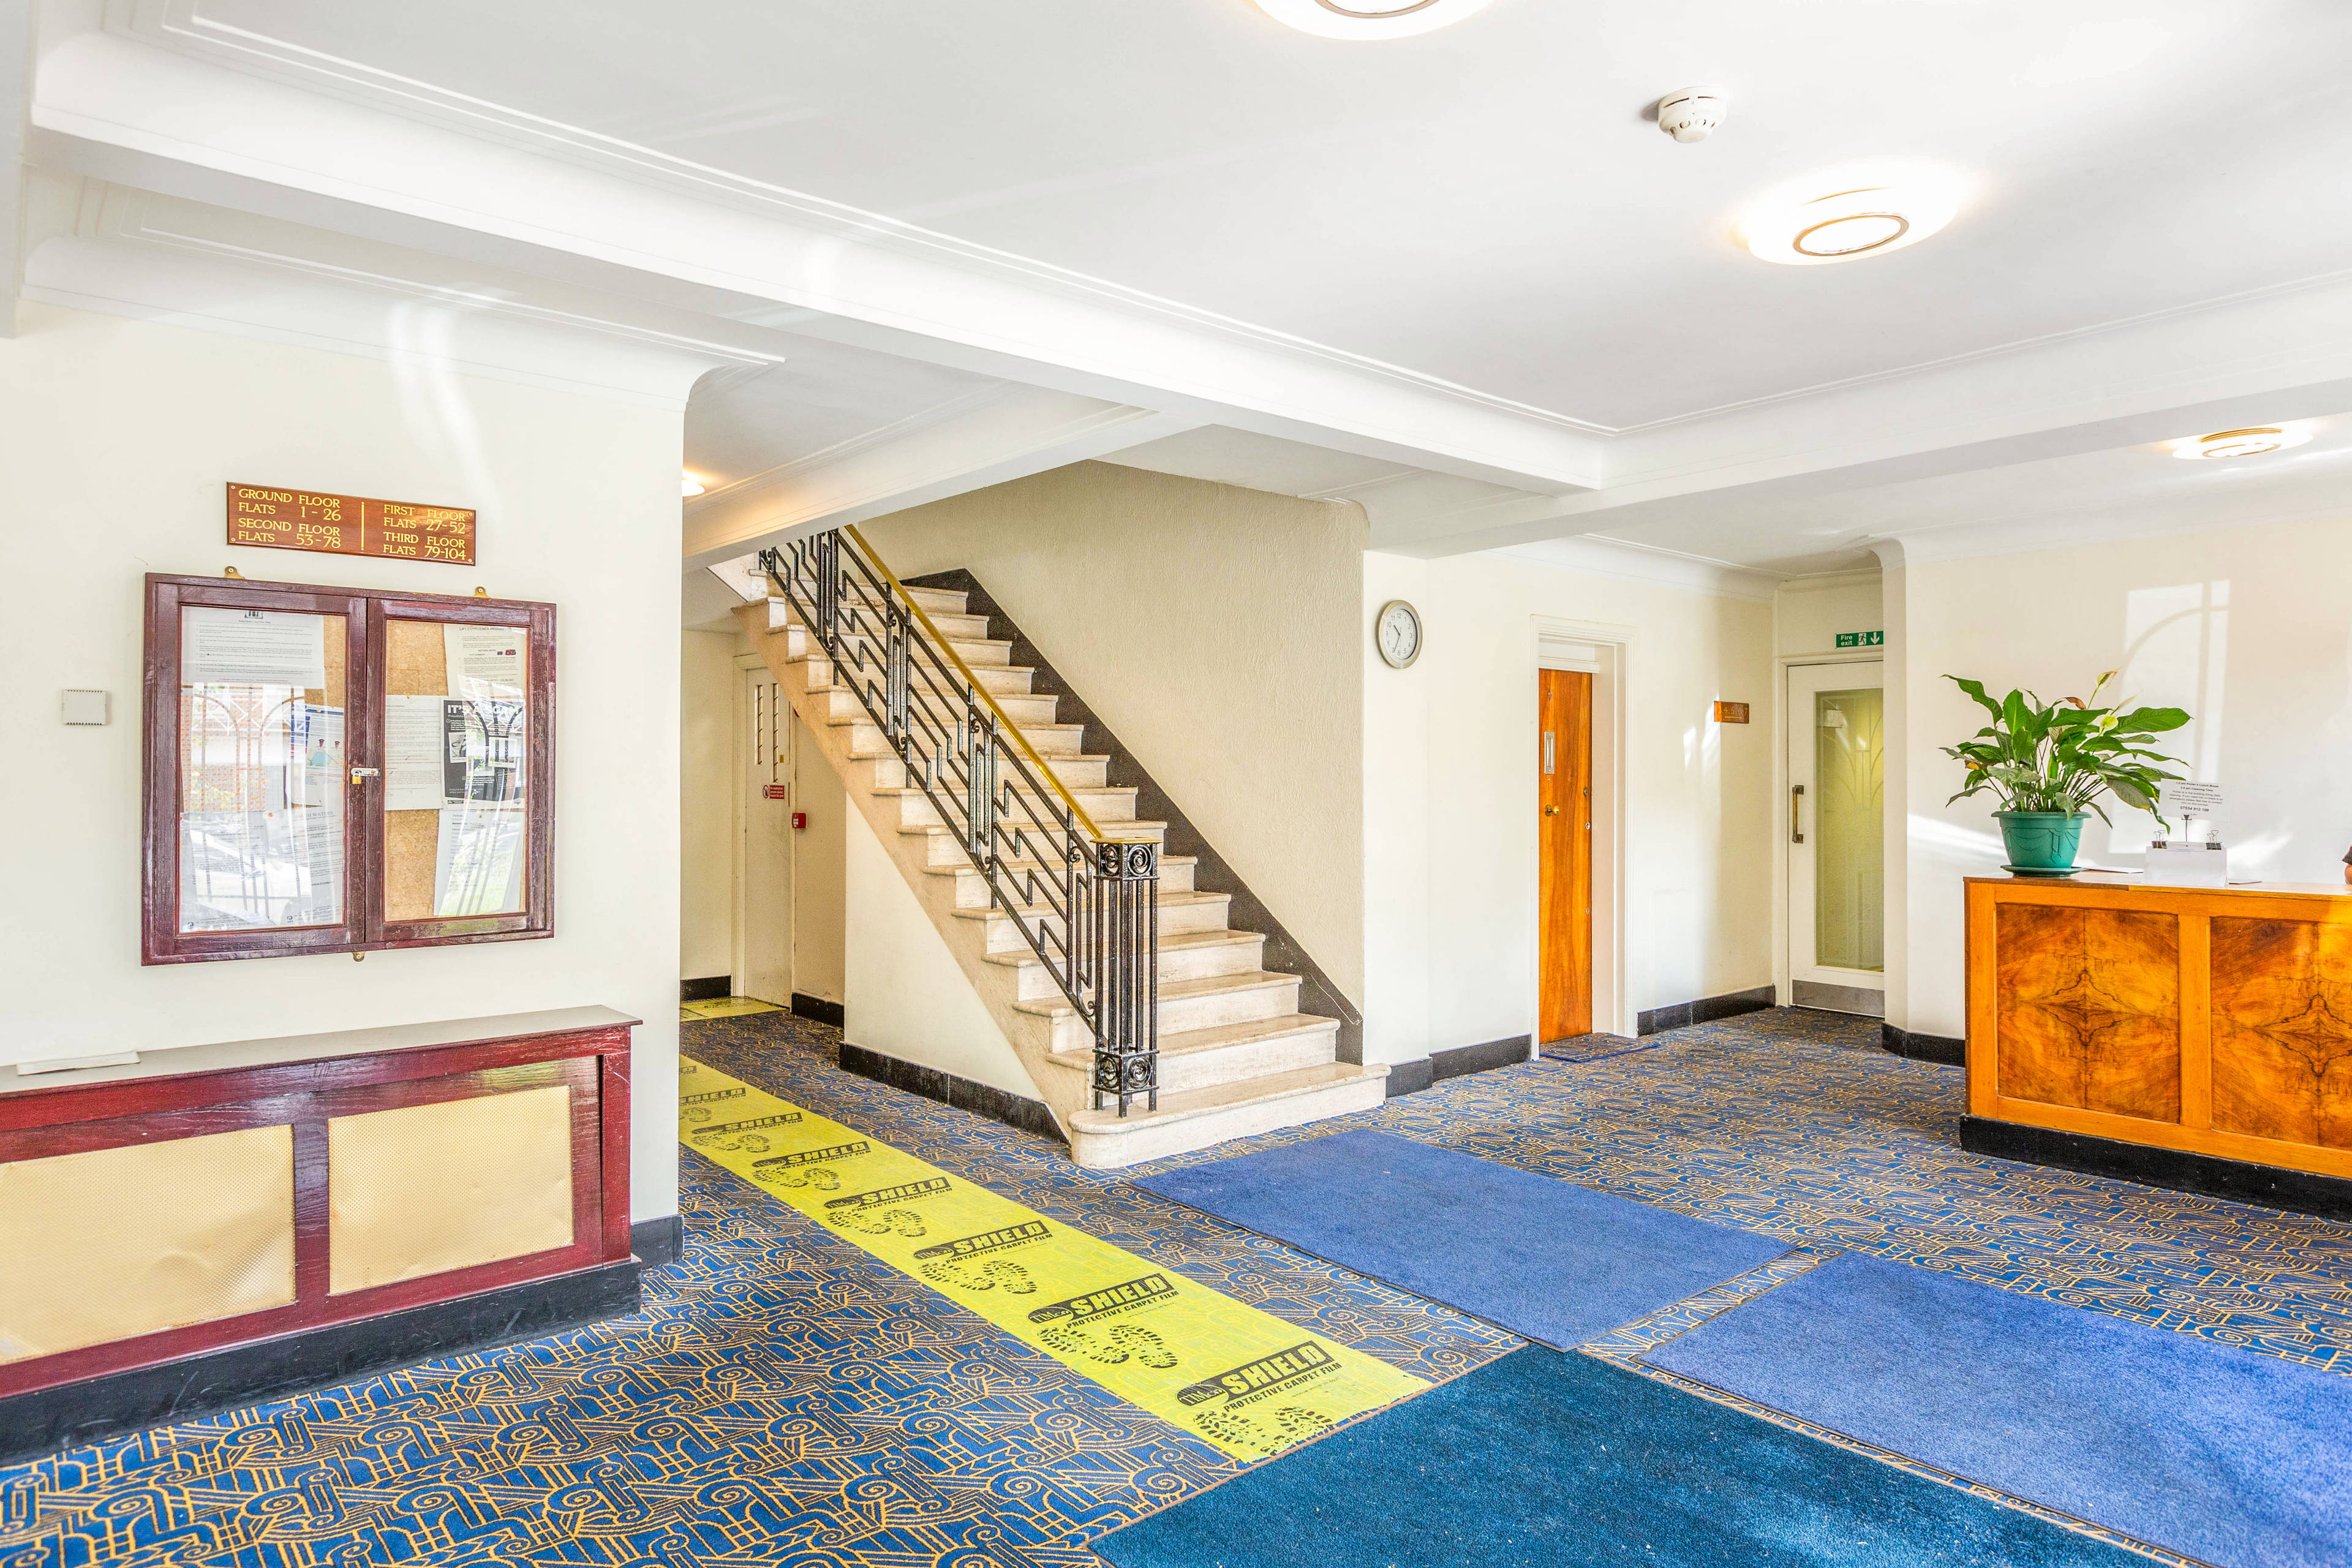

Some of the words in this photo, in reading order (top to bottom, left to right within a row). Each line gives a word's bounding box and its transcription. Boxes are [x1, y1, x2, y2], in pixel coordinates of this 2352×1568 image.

[239, 489, 292, 502] GROUND
[299, 495, 341, 508] FLOOR
[239, 502, 276, 514] FLATS
[301, 507, 305, 518] 1
[323, 508, 341, 521] 26
[384, 505, 415, 516] FIRST
[428, 510, 465, 521] FLOOR
[238, 518, 292, 531] SECOND
[299, 523, 341, 537] FLOOR
[384, 517, 417, 529] FLATS
[426, 519, 466, 534] 27-52
[238, 530, 274, 542] FLATS
[296, 533, 341, 548] 53-78
[383, 532, 418, 543] THIRD
[427, 536, 466, 548] FLOOR
[383, 544, 416, 556] FLATS
[424, 546, 466, 560] 79-104
[1547, 692, 1553, 703] 7
[725, 1114, 798, 1131] SHIELD
[787, 1142, 865, 1163] SHIELD
[862, 1178, 946, 1204] SHIELD
[852, 1199, 901, 1212] PROTECTIVE
[903, 1192, 933, 1200] CARPET
[953, 1223, 1044, 1254] SHIELD
[946, 1248, 998, 1264] PROTECTIVE
[1001, 1239, 1031, 1250] CARPET
[1071, 1276, 1168, 1316] SHIELD
[1066, 1307, 1121, 1329] PROTECTIVE
[1124, 1298, 1158, 1311] CARPET
[1159, 1291, 1180, 1300] FILM
[1221, 1344, 1328, 1395] SHIELD
[1223, 1384, 1284, 1412] PROTECTIVE
[1284, 1371, 1319, 1389] CARPET
[1321, 1362, 1342, 1374] FILM
